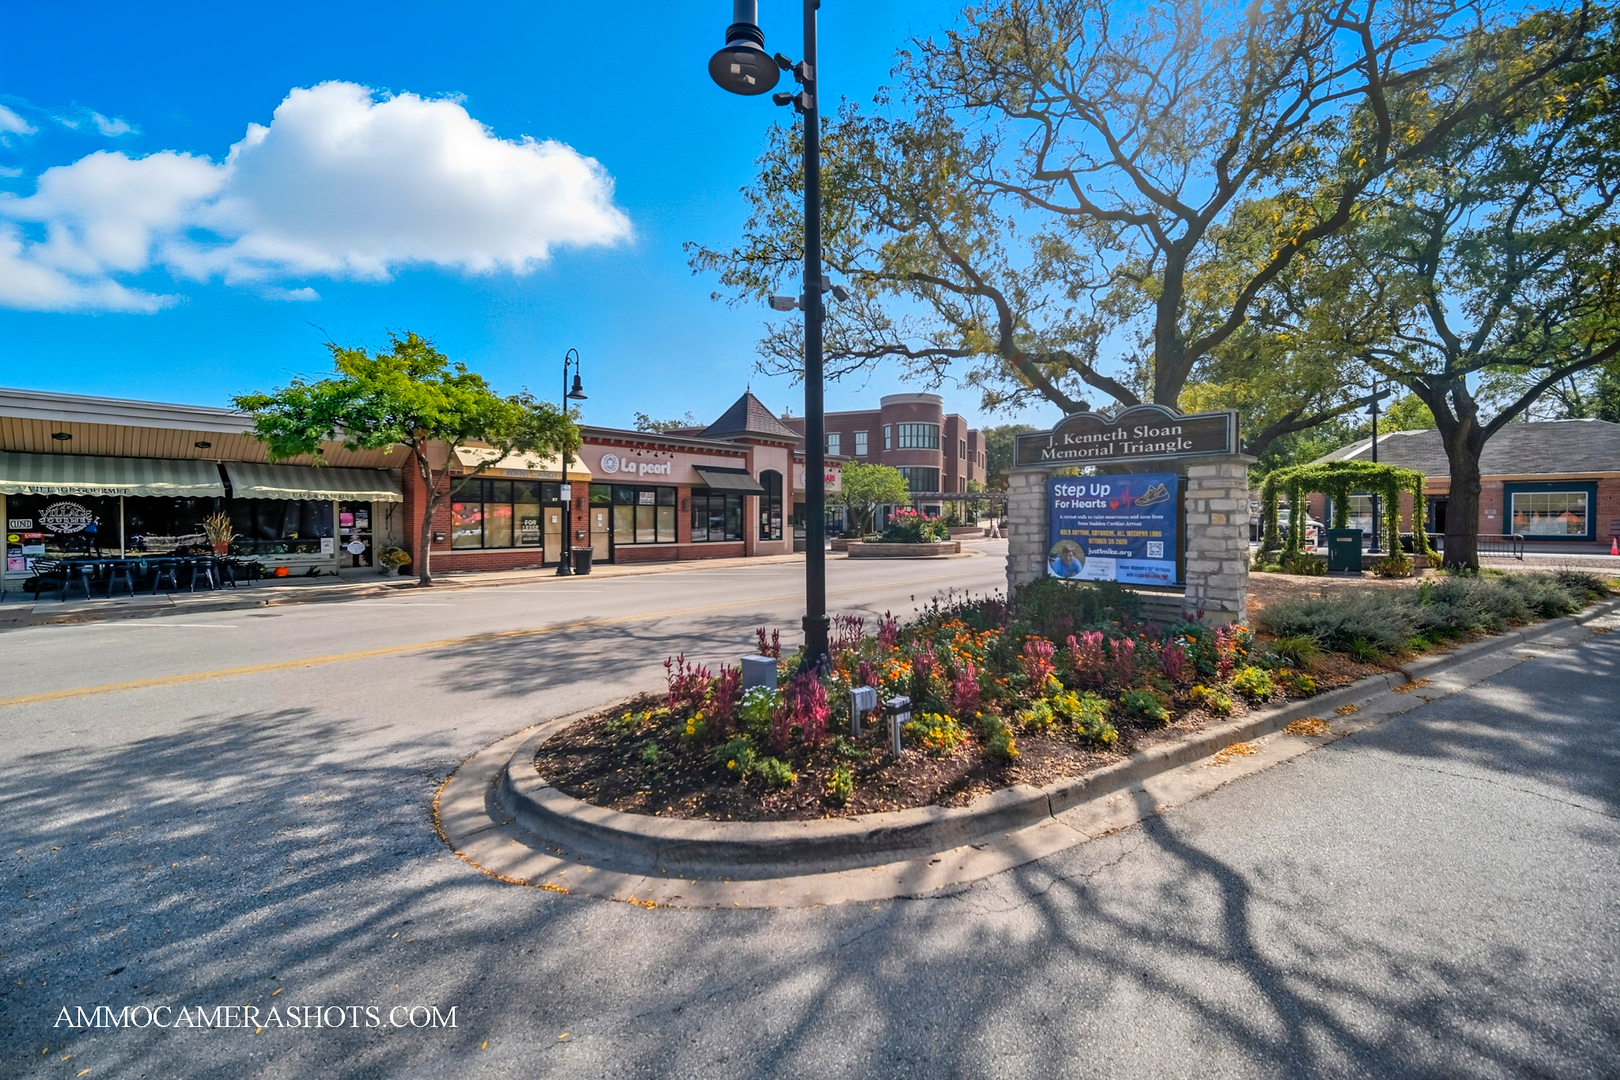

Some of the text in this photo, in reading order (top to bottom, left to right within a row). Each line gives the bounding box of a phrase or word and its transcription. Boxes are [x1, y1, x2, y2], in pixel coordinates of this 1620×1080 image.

[1046, 425, 1183, 449] J. Kenneth Sloan
[1040, 437, 1193, 460] Memorial Triangle
[621, 458, 671, 477] La pearl
[78, 487, 128, 495] GOURMET
[1054, 483, 1111, 498] Step Up
[1054, 499, 1107, 509] For Hearts
[38, 509, 93, 518] VILLAGE
